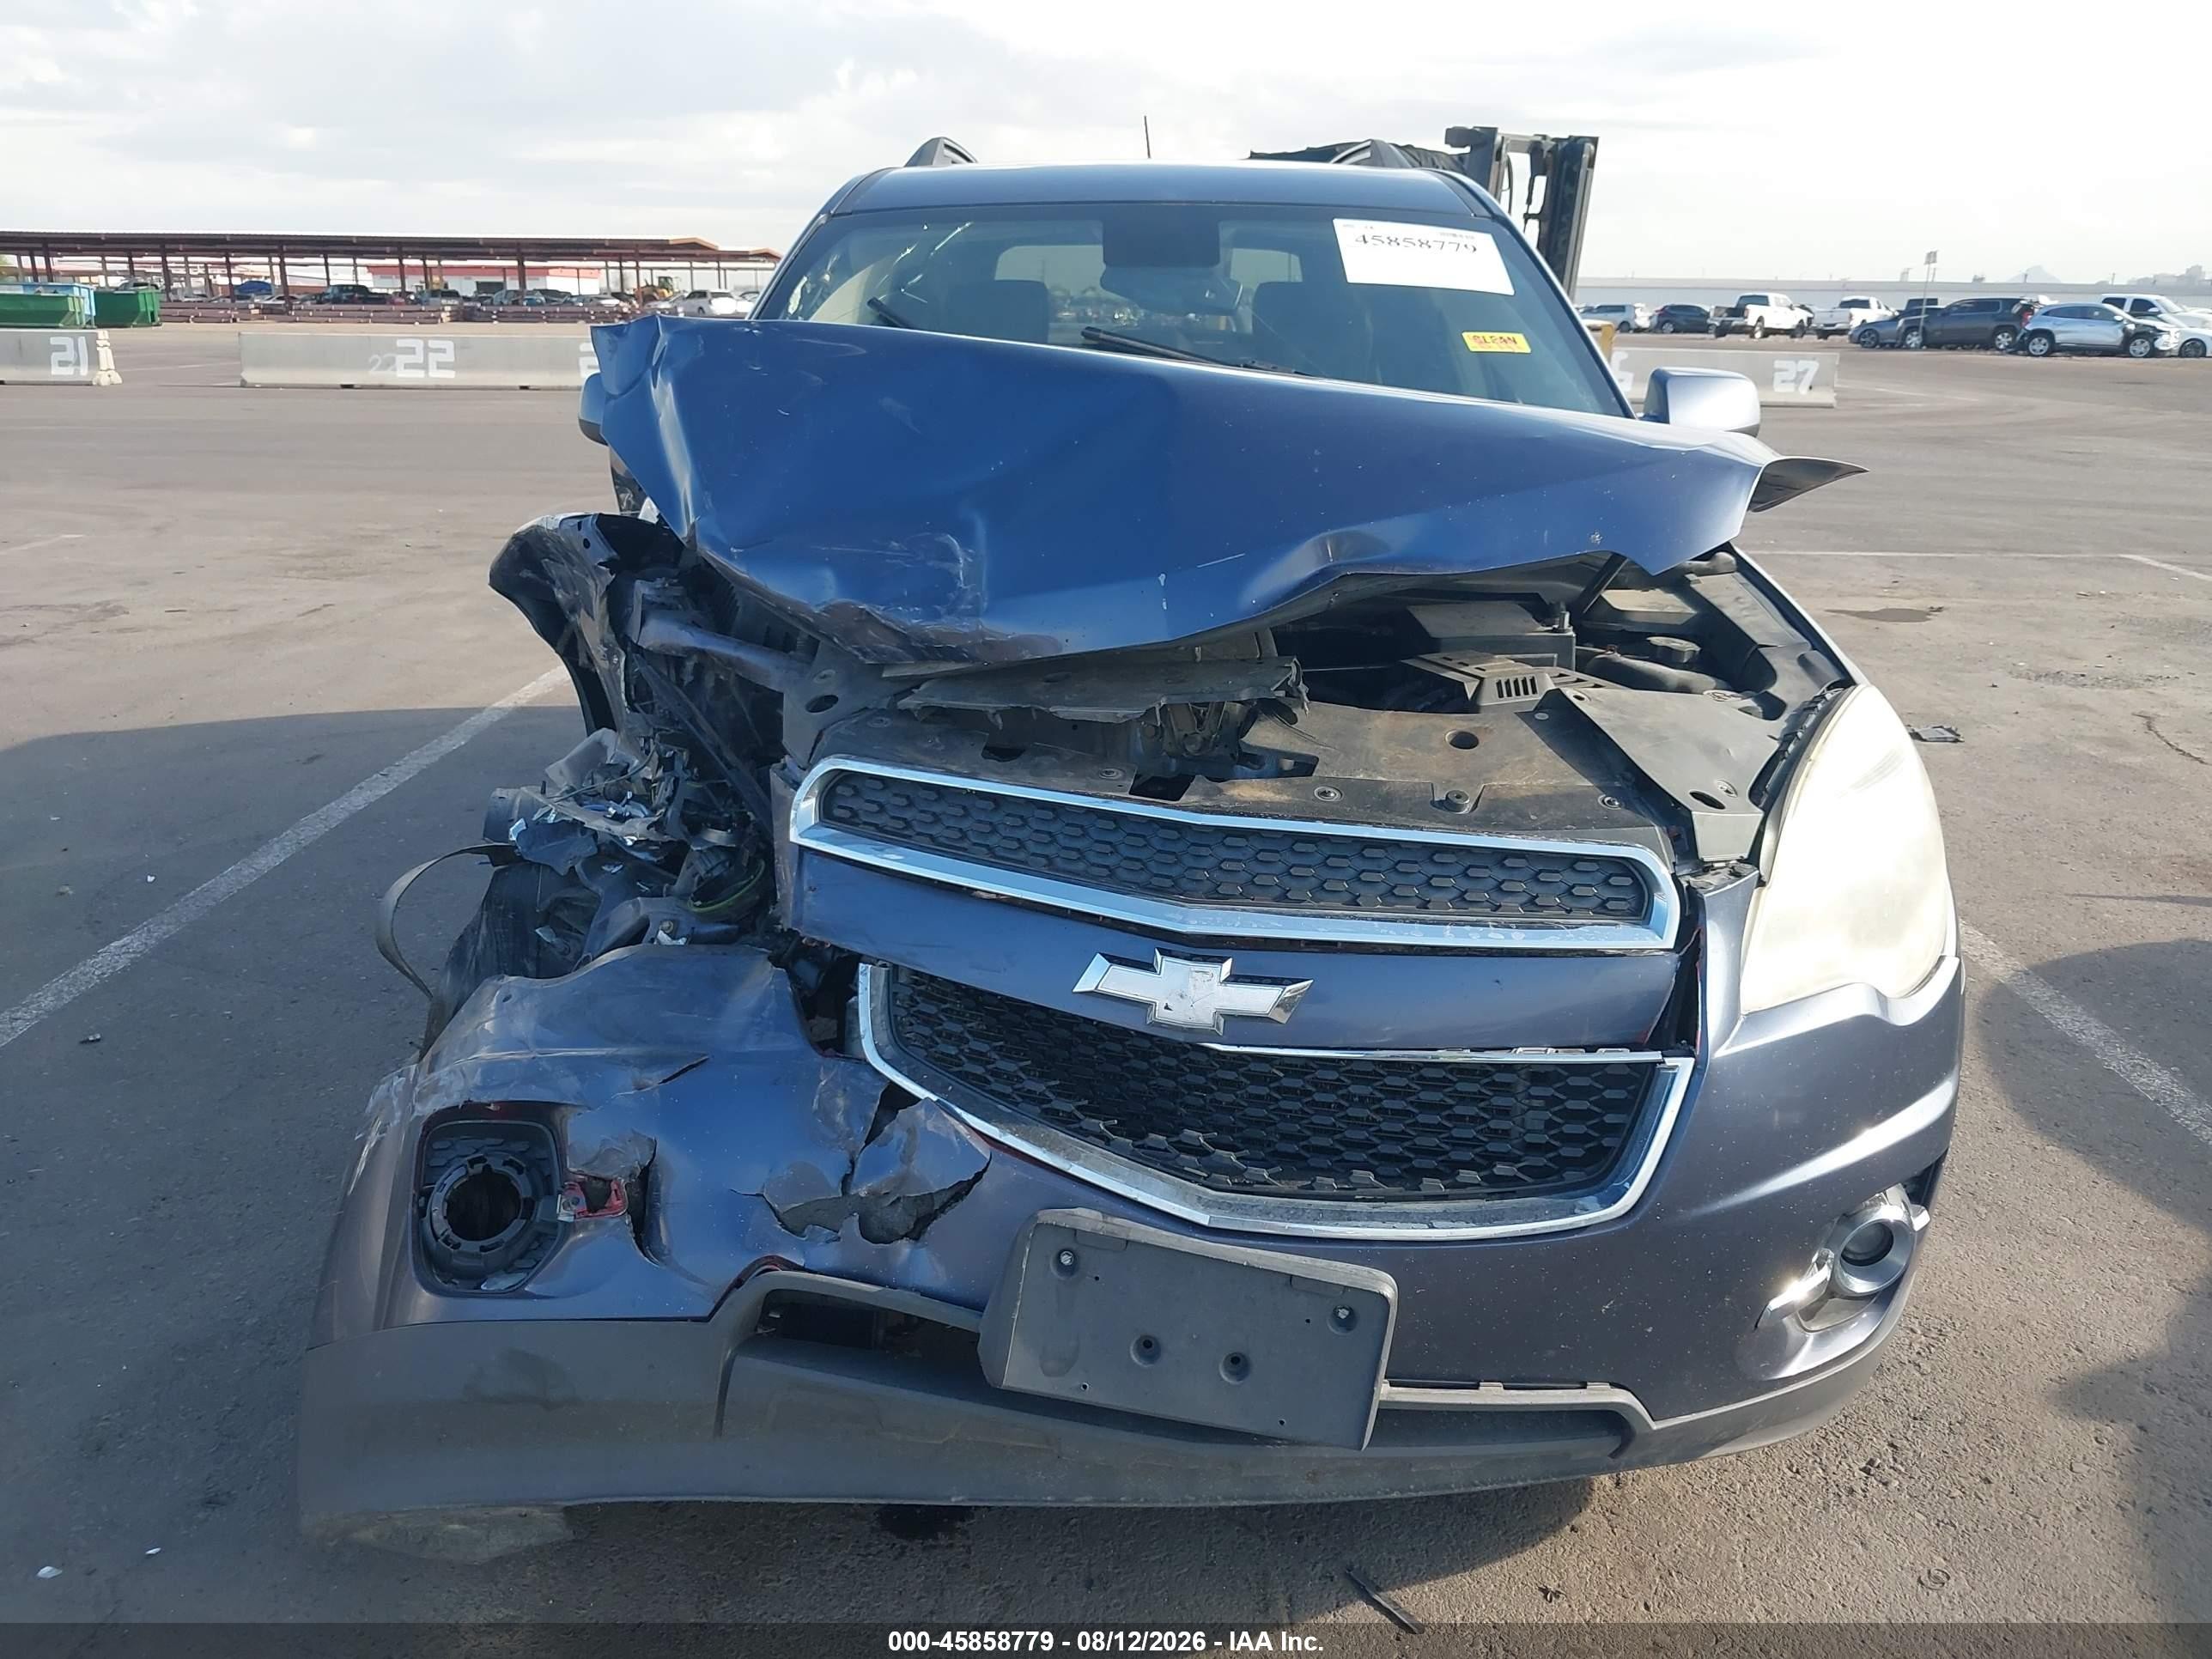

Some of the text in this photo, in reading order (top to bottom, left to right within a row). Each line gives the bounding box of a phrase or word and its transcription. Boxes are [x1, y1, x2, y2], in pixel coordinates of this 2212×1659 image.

[1355, 234, 1477, 253] 45858779
[50, 336, 88, 376] 21
[396, 338, 456, 379] 22
[1773, 359, 1820, 395] 27
